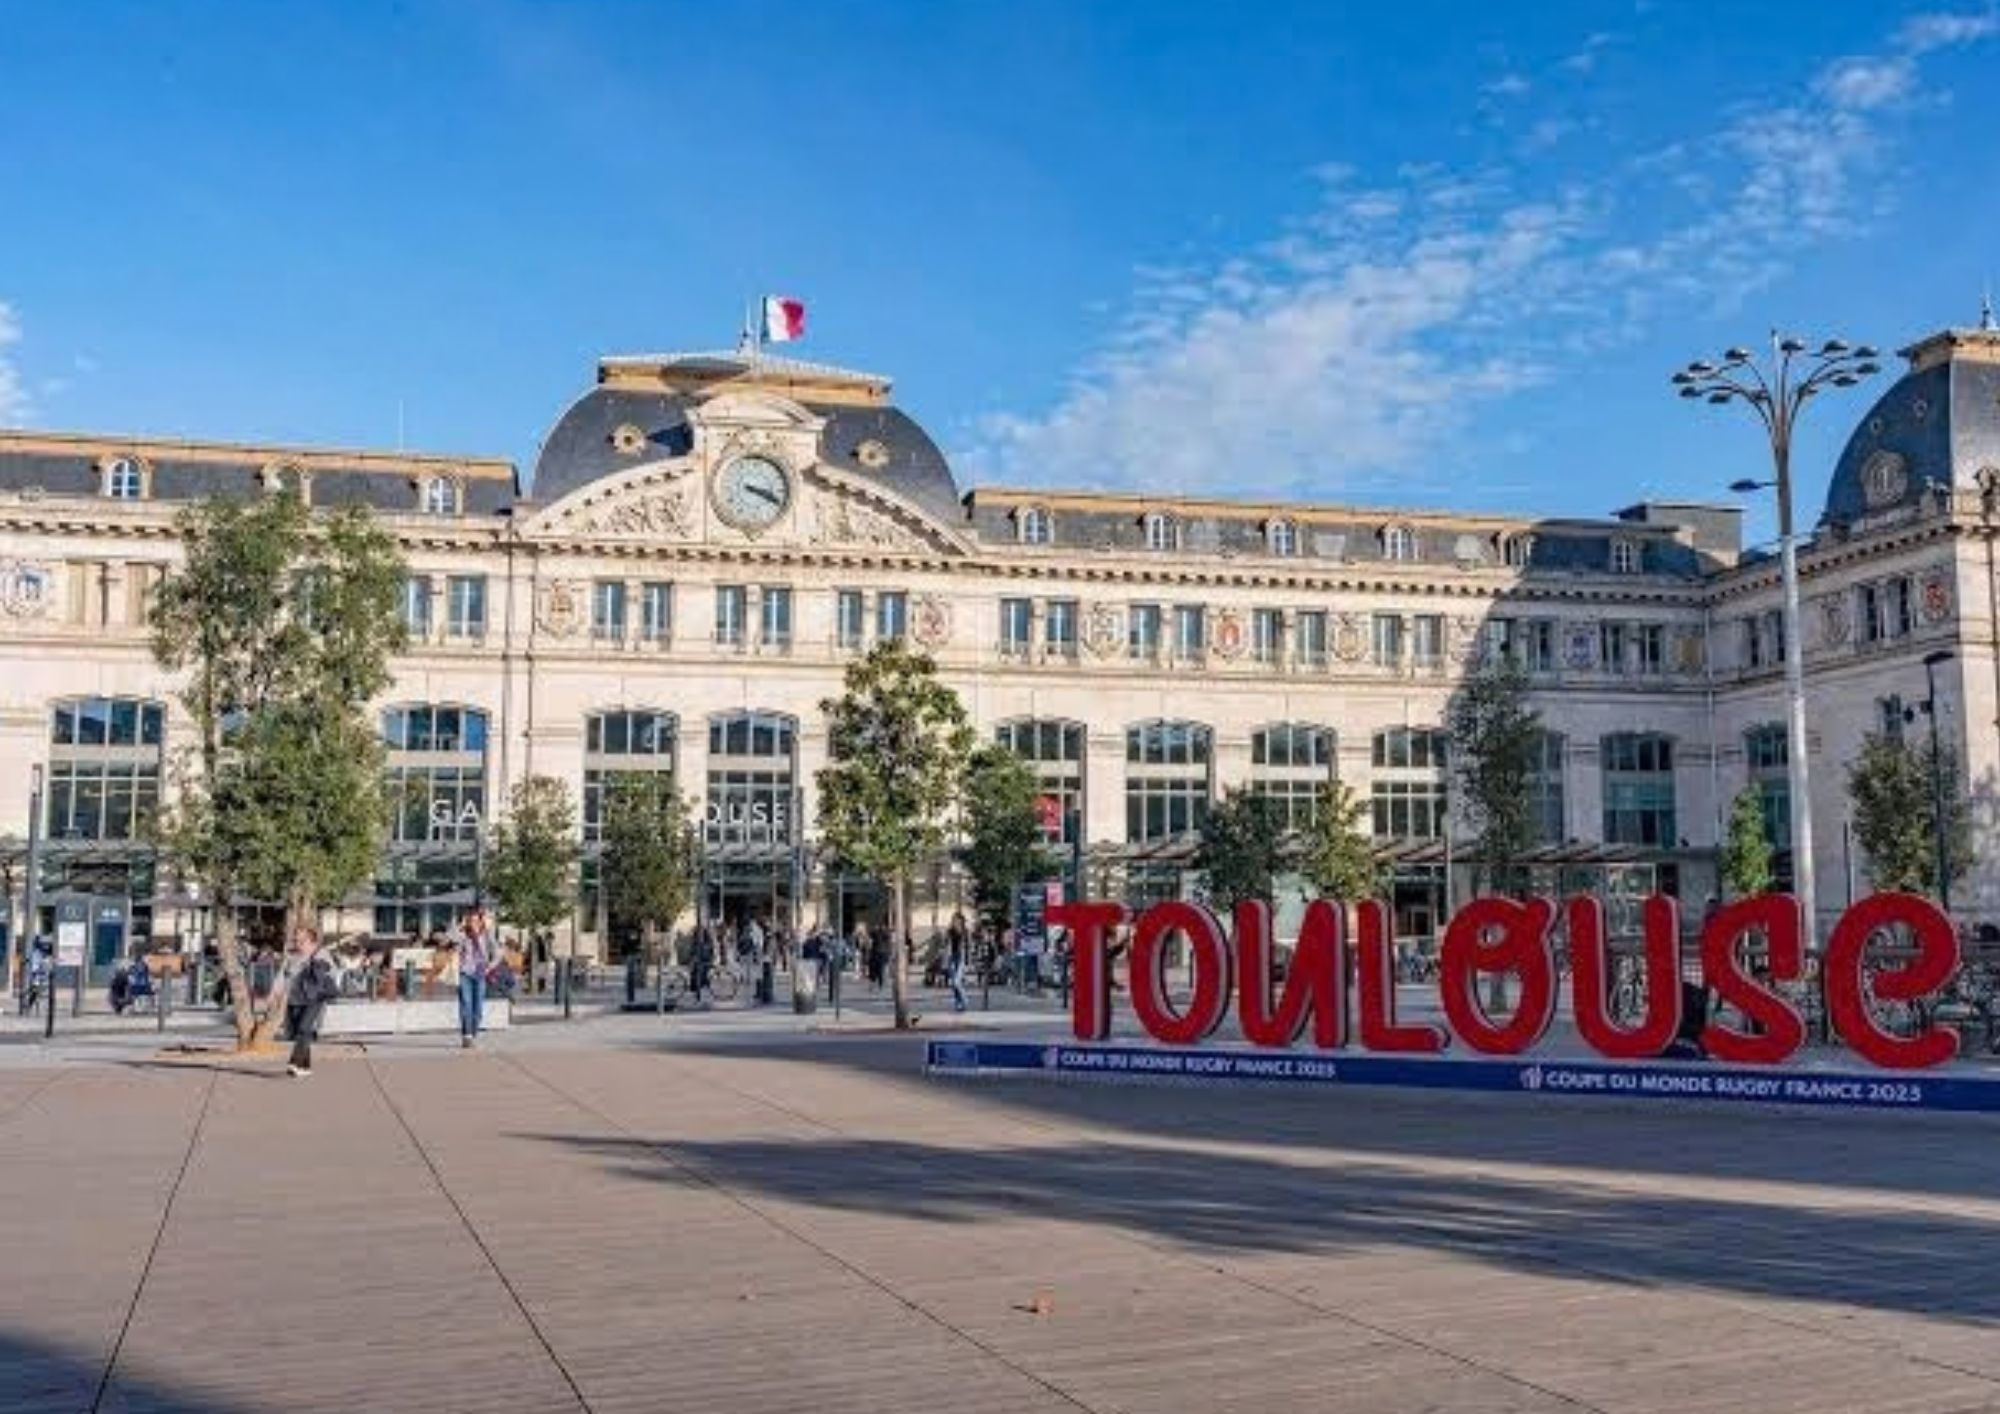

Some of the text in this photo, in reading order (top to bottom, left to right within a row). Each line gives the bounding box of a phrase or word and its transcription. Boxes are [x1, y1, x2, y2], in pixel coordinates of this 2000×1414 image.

[1106, 1053, 1128, 1068] DU
[1129, 1054, 1182, 1070] MONDE
[1185, 1056, 1233, 1072] RUGBY
[1235, 1059, 1294, 1076] FRANCE
[1546, 1070, 1606, 1088] COUPE
[1609, 1073, 1638, 1089] DU
[1641, 1075, 1712, 1092] MONDE
[1714, 1076, 1782, 1096] RUGBY
[1784, 1079, 1864, 1099] FRANCE
